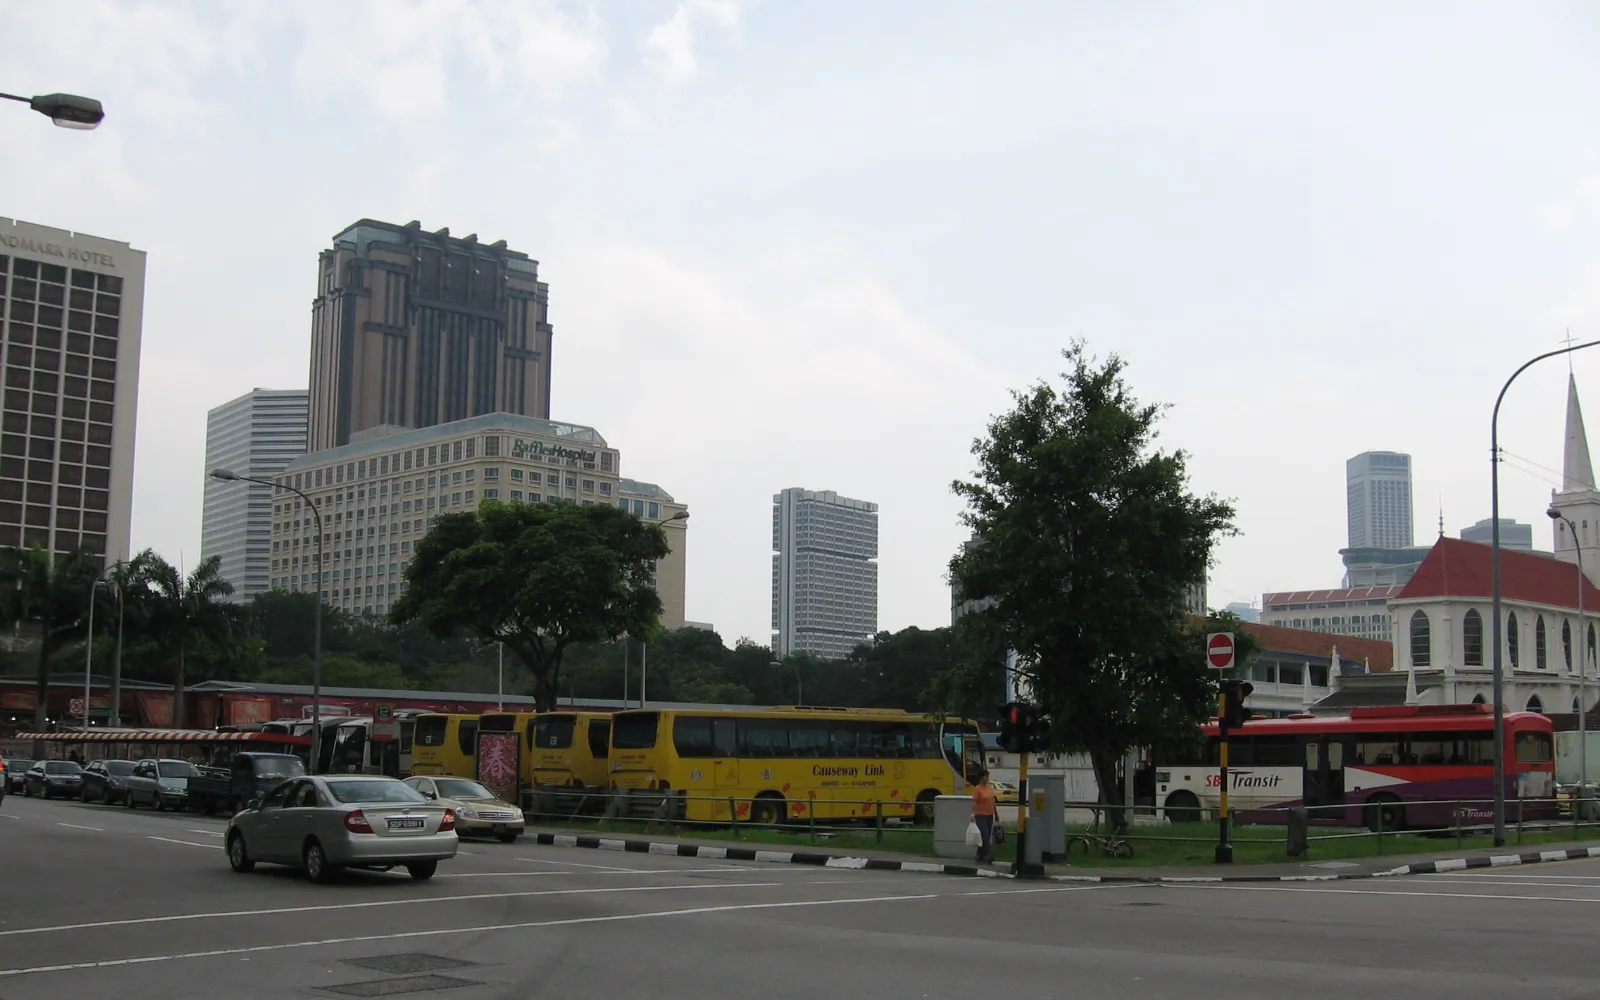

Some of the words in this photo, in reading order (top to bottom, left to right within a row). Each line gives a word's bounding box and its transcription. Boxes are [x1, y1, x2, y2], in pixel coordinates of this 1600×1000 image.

[68, 247, 116, 268] HOTEL
[482, 740, 517, 779] 春
[813, 764, 859, 778] Causeway
[865, 764, 885, 776] Link
[1228, 769, 1283, 790] Transit
[1464, 808, 1495, 818] Transit
